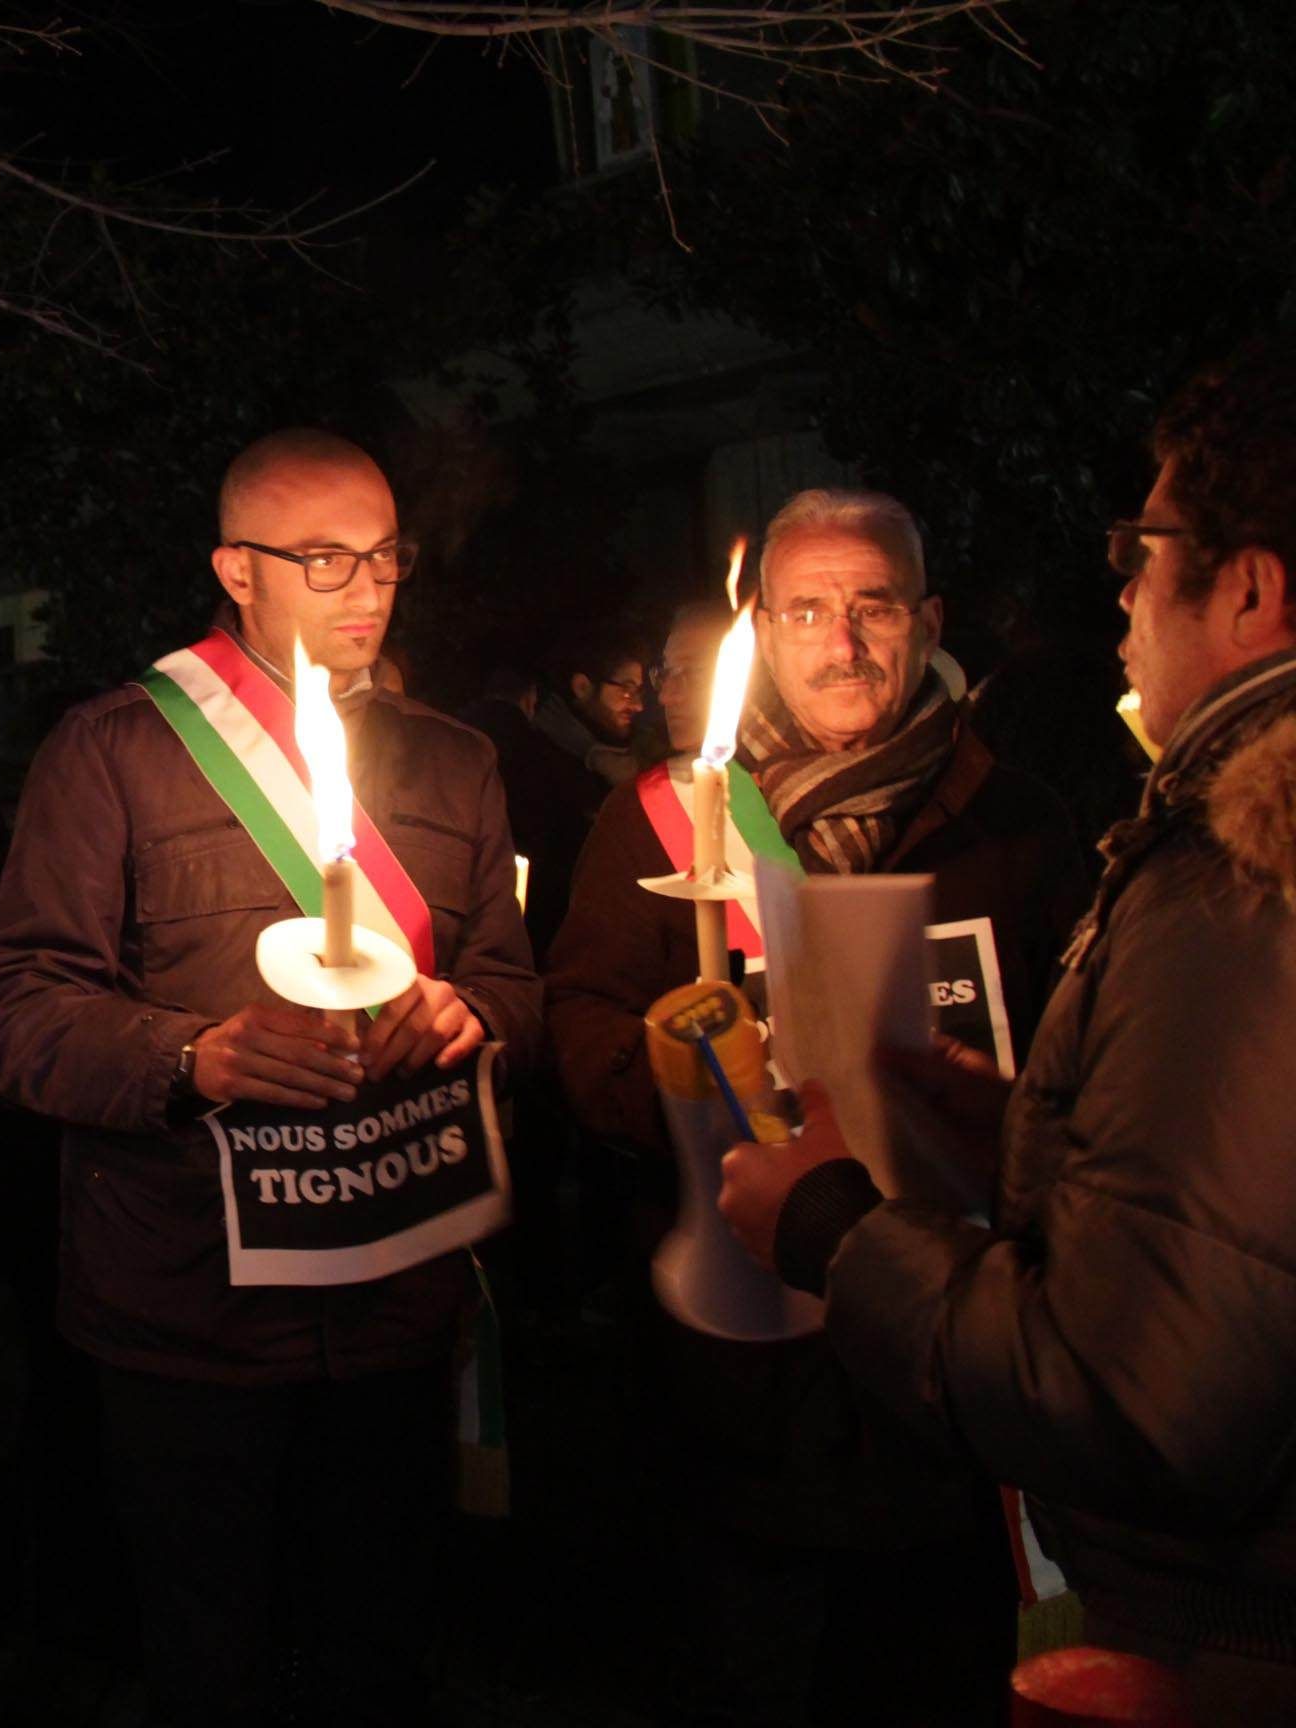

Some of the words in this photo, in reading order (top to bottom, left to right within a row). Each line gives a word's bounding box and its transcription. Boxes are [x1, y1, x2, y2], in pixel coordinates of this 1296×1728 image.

[229, 1125, 326, 1152] NOUS
[333, 1079, 471, 1150] SOMMES
[250, 1125, 468, 1204] TIGNOUS
